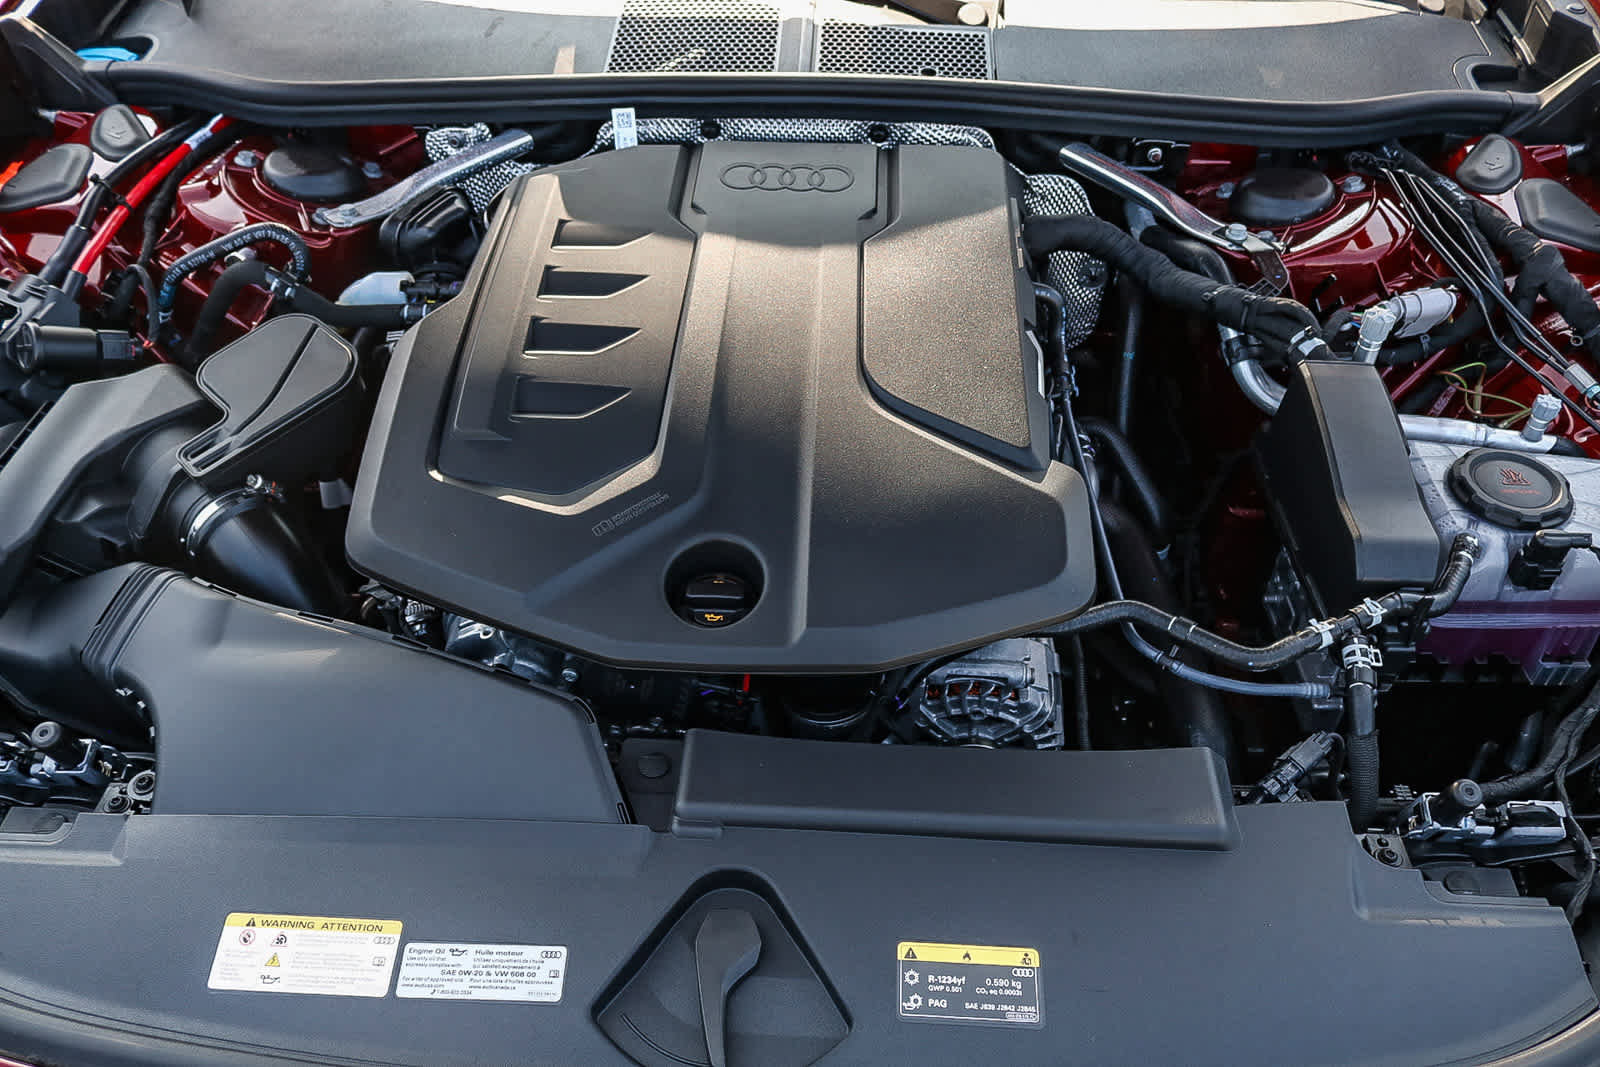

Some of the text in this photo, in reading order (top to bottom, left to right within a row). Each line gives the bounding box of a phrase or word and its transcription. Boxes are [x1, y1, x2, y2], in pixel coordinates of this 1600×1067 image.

[261, 919, 384, 932] WARNING ATTENTION
[408, 947, 433, 955] Engine
[928, 975, 966, 986] R-1234yf
[985, 978, 1022, 989] 0.590 kg
[928, 998, 947, 1008] PAG
